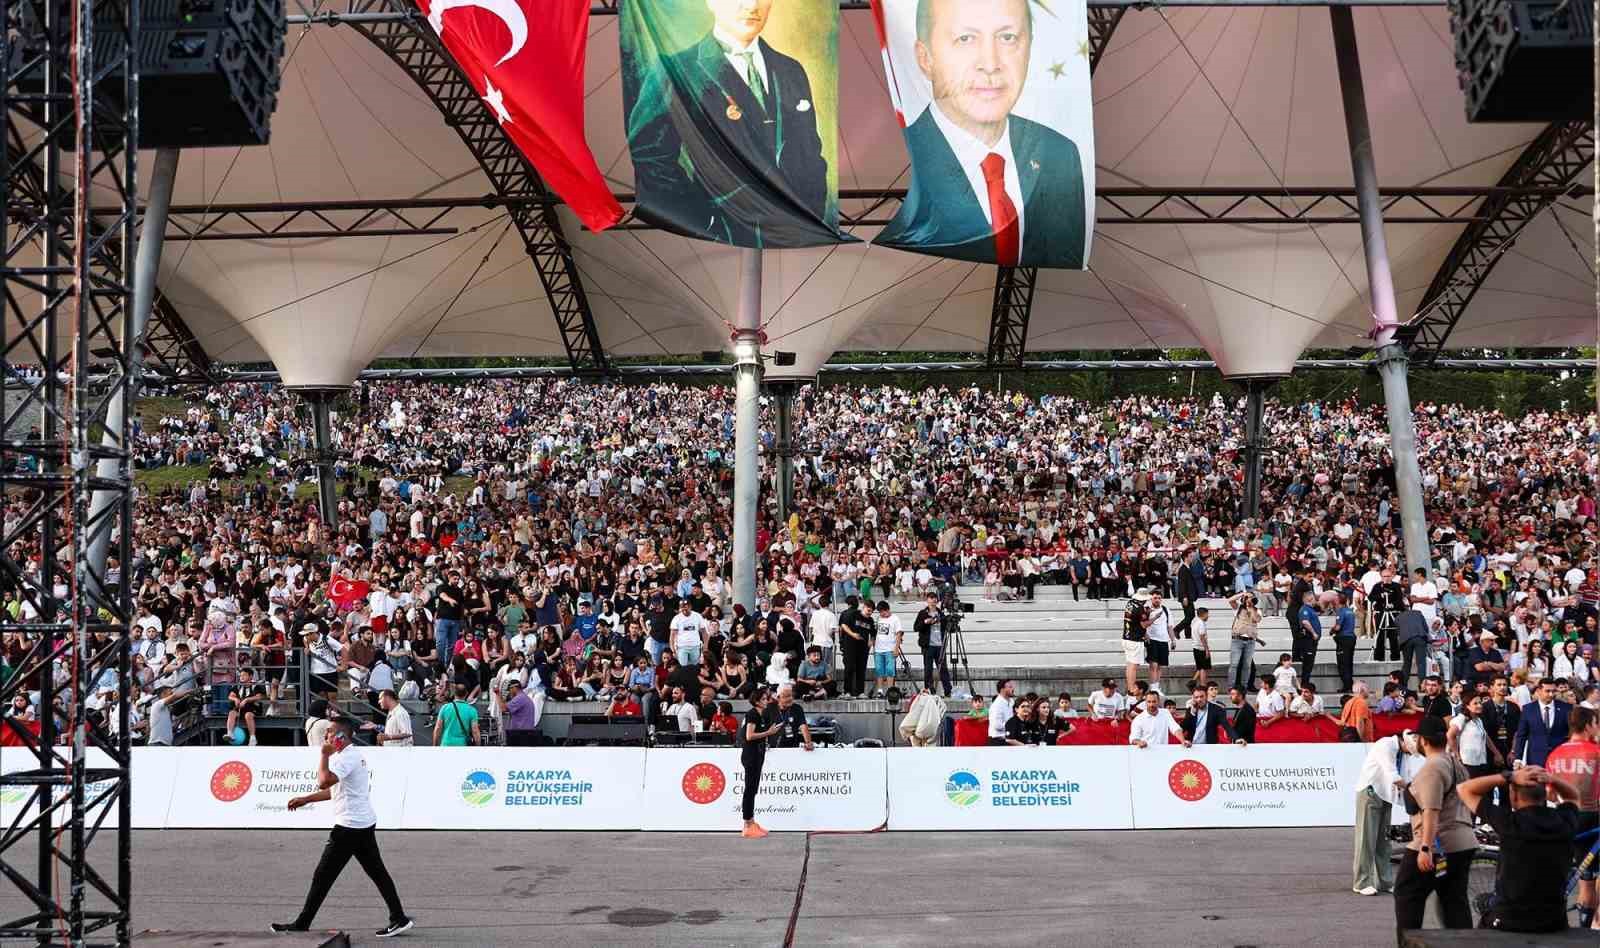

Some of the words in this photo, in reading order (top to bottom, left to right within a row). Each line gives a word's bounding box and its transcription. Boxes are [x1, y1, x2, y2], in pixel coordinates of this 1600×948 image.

[261, 768, 301, 780] TÜRKİYE
[507, 770, 572, 780] SAKARYA
[779, 770, 852, 782] CUMHURİYETİ
[991, 770, 1057, 781] SAKARYA
[1218, 767, 1261, 778] TÜRKİYE
[1263, 766, 1335, 778] CUMHURİYETİ
[506, 780, 593, 794] BÜYÜKŞEHİR
[991, 780, 1080, 795] BÜYÜKŞEHİR
[1219, 781, 1338, 792] CUMHURBAŞKANLIĞI
[505, 793, 583, 806] BELEDİYESİ
[992, 794, 1072, 806] BELEDİYESİ
